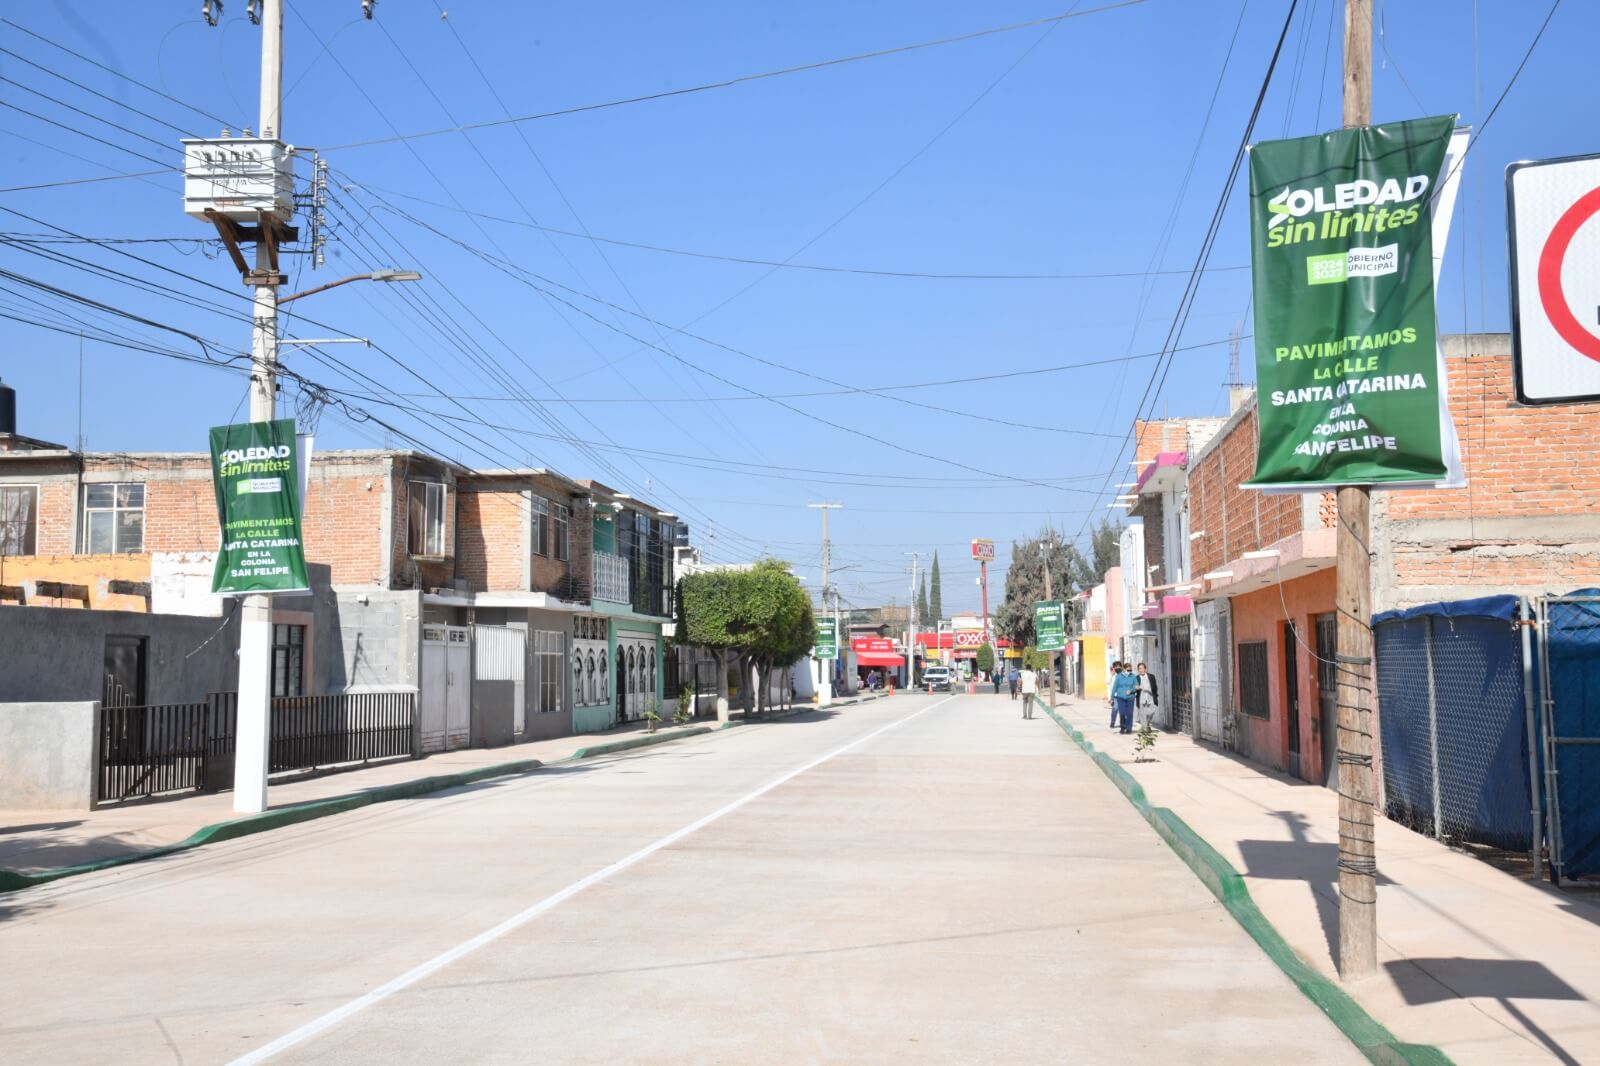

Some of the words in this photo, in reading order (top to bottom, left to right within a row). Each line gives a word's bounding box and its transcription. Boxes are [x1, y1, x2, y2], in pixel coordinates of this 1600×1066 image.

[1268, 175, 1429, 230] SOLEDAD
[1267, 217, 1316, 248] sin
[1347, 252, 1394, 263] OBIERNO
[1312, 259, 1344, 270] 2024
[1347, 261, 1394, 272] UNICIPAL
[1313, 269, 1344, 280] 2027
[1313, 366, 1331, 380] LA
[1335, 356, 1379, 377] CLLE
[1271, 386, 1333, 406] SANTA
[1312, 418, 1369, 436] COONIA
[1326, 435, 1397, 455] FELIPE
[220, 463, 241, 477] sin
[247, 529, 280, 538] CALLE
[250, 538, 299, 548] CATARINA
[241, 558, 276, 566] COLONIA
[231, 569, 251, 577] SAN
[254, 566, 289, 576] FELIPE
